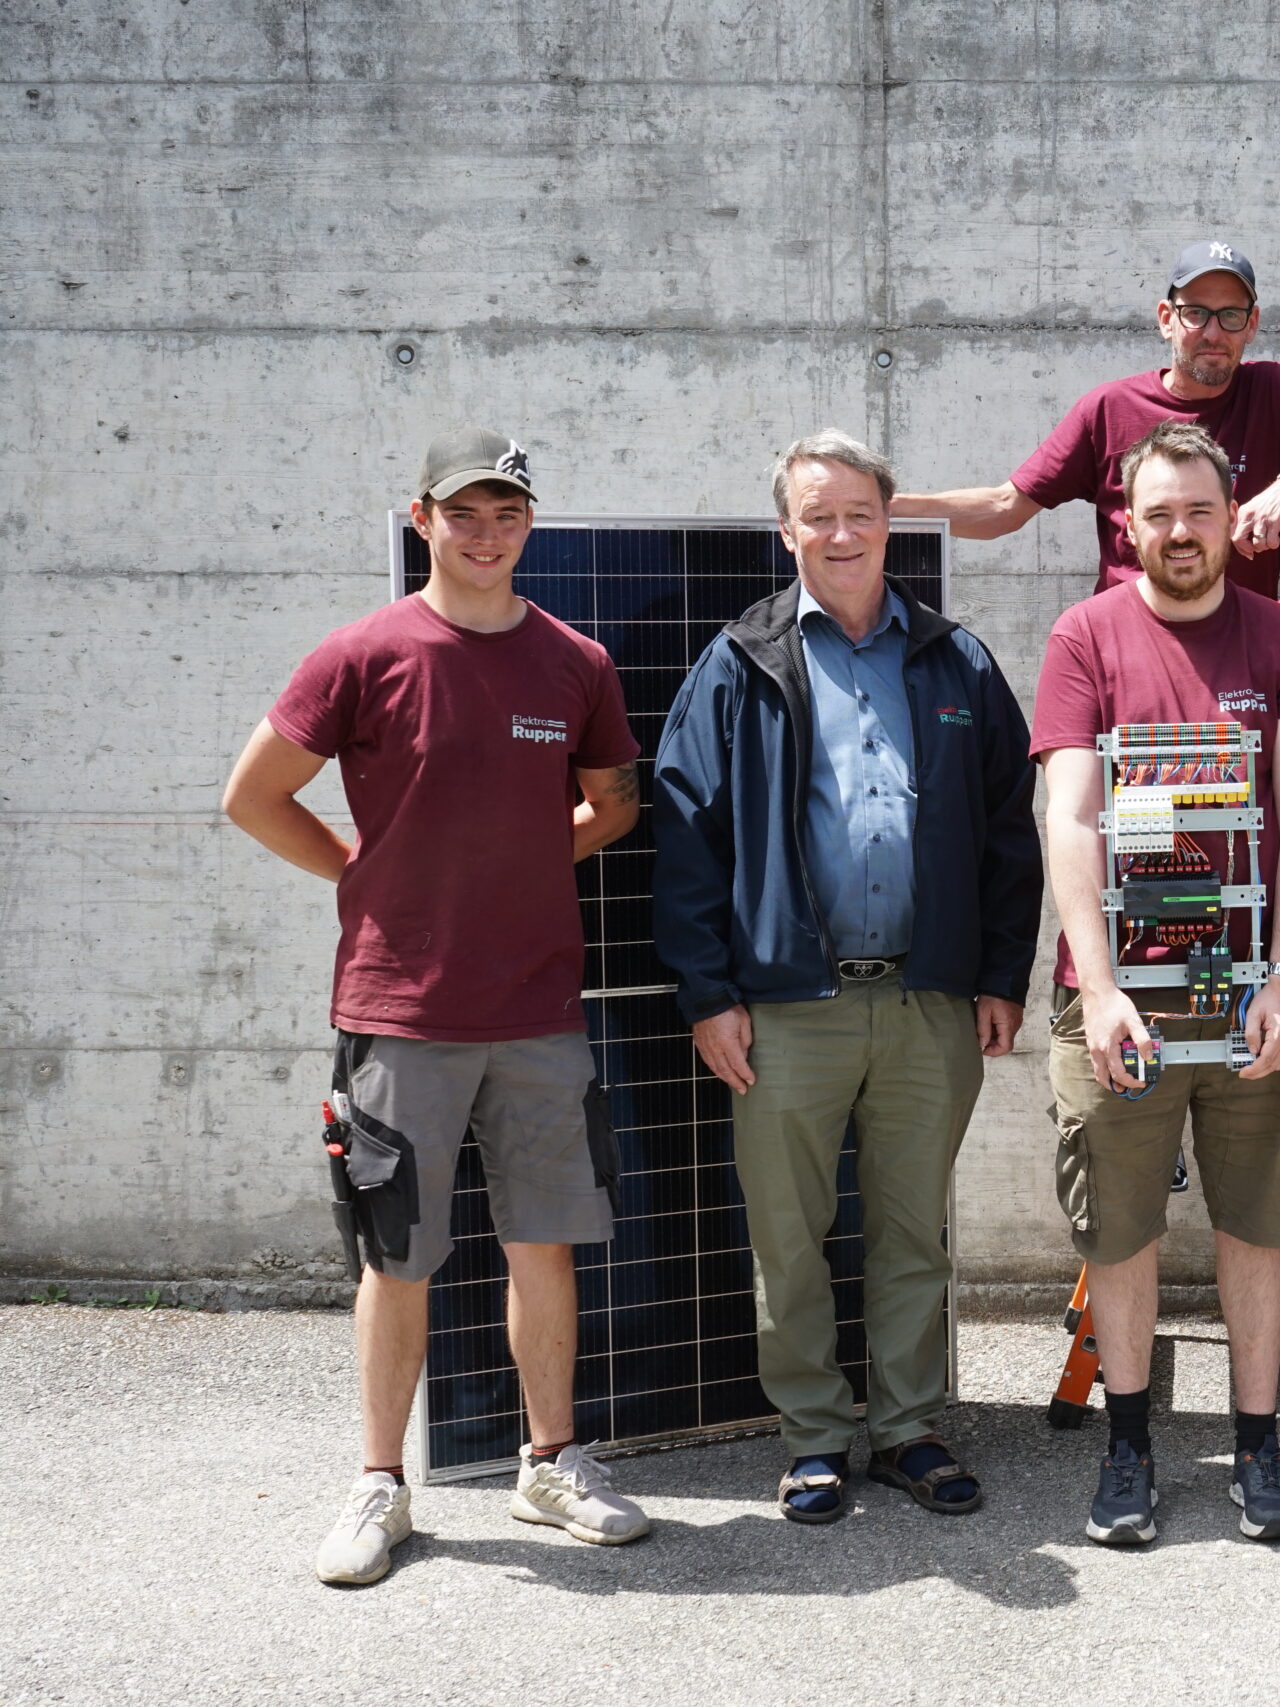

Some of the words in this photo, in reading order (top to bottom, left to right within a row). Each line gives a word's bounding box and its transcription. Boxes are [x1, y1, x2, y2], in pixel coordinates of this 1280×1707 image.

[1218, 688, 1253, 700] Elektro
[1219, 698, 1268, 712] Ruppn
[512, 714, 548, 726] Elektro
